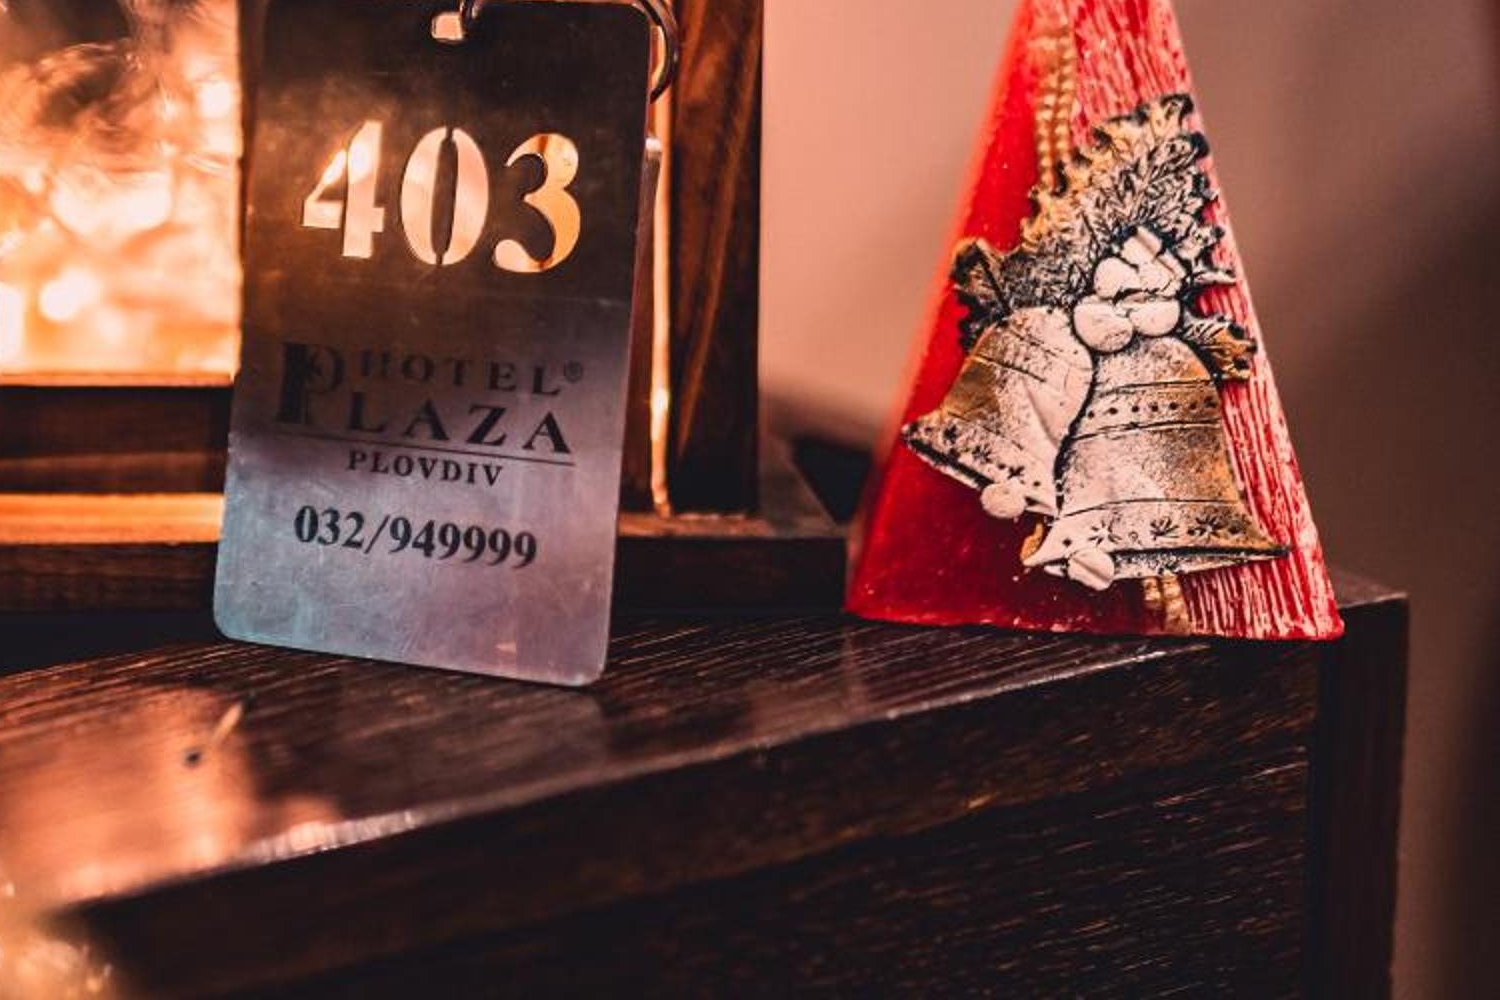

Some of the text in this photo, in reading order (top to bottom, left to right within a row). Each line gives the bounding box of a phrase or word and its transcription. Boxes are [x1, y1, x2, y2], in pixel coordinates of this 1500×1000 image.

[302, 119, 582, 274] 403
[275, 341, 572, 455] PLAZA
[346, 450, 503, 487] PLOVDIV
[294, 504, 538, 570] 032/949999
